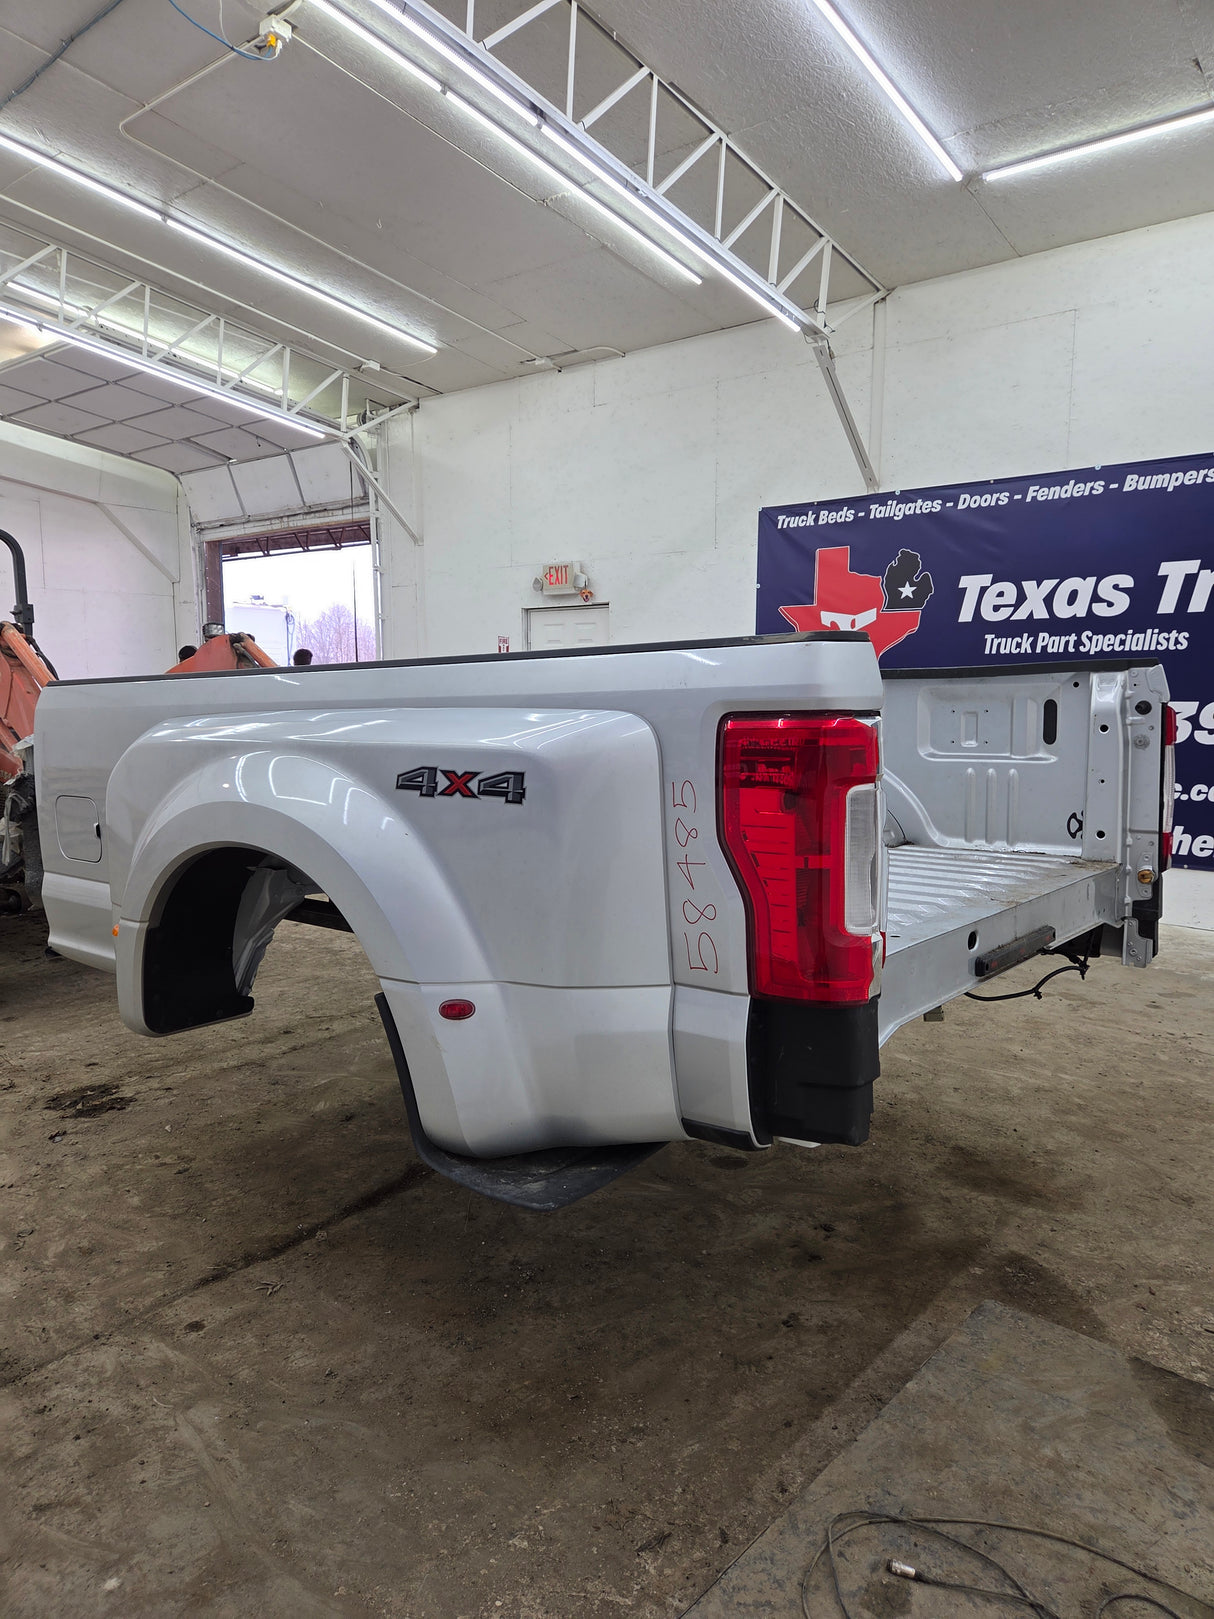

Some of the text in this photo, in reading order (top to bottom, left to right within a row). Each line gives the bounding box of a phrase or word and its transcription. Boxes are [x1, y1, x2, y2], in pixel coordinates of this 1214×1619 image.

[777, 511, 816, 529] Truck
[818, 507, 855, 525] Beds
[869, 499, 942, 520] Tailgates
[957, 492, 1010, 510] Doors
[1025, 480, 1105, 502] Fenders
[1122, 467, 1214, 492] Bumpers
[548, 565, 569, 586] EXIT
[957, 559, 1214, 622] Texas Tr
[984, 628, 1190, 655] Truck Part Specialists
[671, 779, 719, 974] 58485
